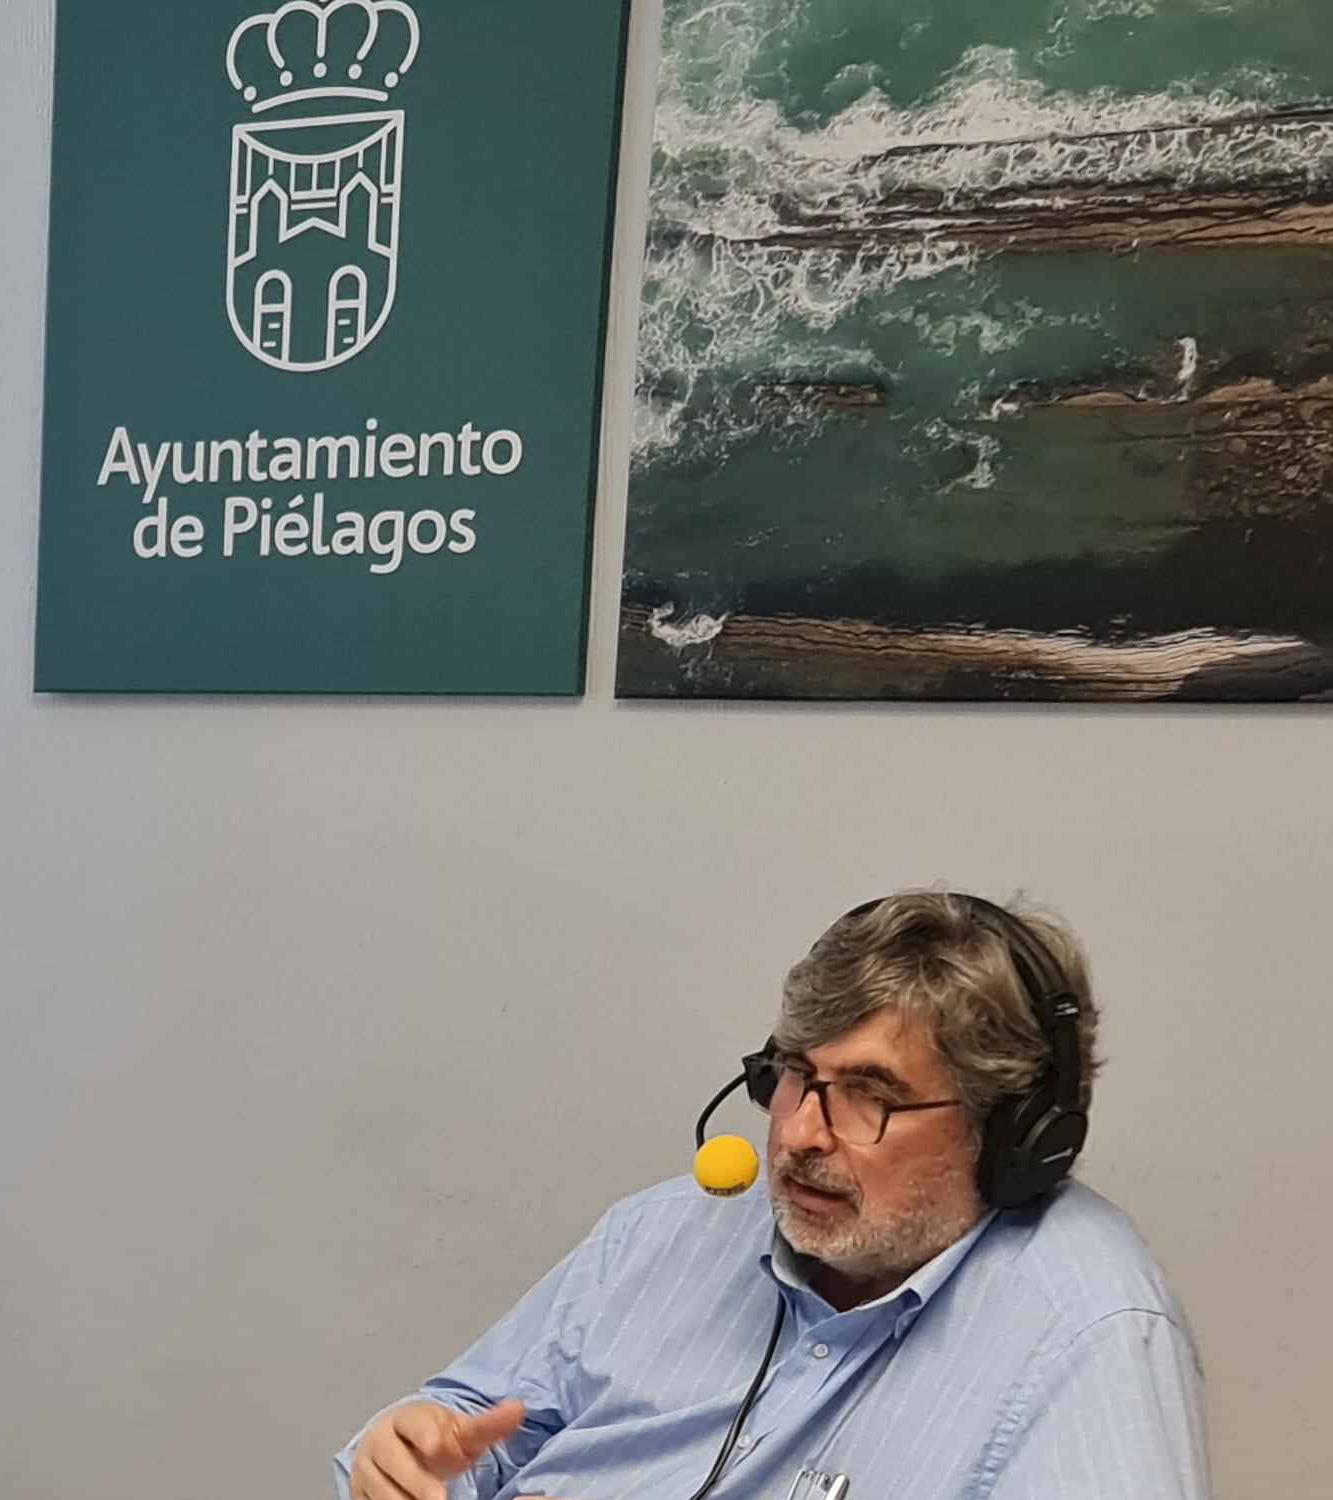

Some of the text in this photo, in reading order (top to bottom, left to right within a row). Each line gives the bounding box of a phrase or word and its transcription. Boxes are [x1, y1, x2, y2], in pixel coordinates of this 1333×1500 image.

[97, 417, 523, 503] Ayuntamiento
[133, 492, 477, 573] de Piélagos
